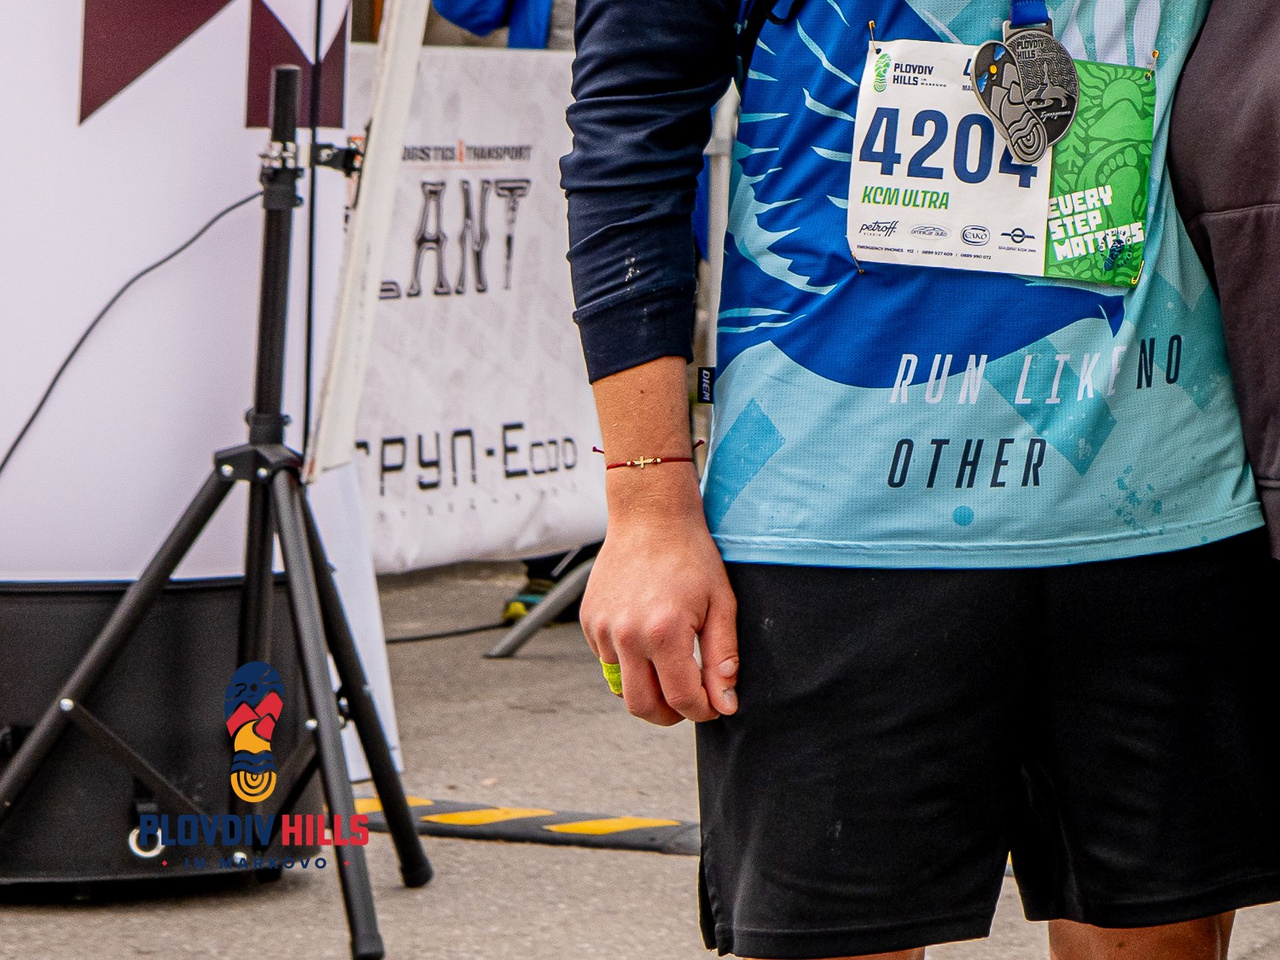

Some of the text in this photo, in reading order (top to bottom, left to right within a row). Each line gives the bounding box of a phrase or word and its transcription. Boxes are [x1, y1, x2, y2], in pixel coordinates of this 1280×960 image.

[1017, 40, 1045, 50] PLOVDIV
[1017, 50, 1036, 59] HILLS
[892, 74, 919, 86] HILLS
[893, 62, 934, 76] PLOVDIV
[861, 185, 950, 210] KCM ULTRA
[1048, 209, 1103, 240] STEP
[1053, 221, 1145, 262] MATTERS
[889, 334, 1183, 405] RUN LIKE NO
[702, 369, 711, 401] DIEM
[887, 438, 1047, 488] OTHER
